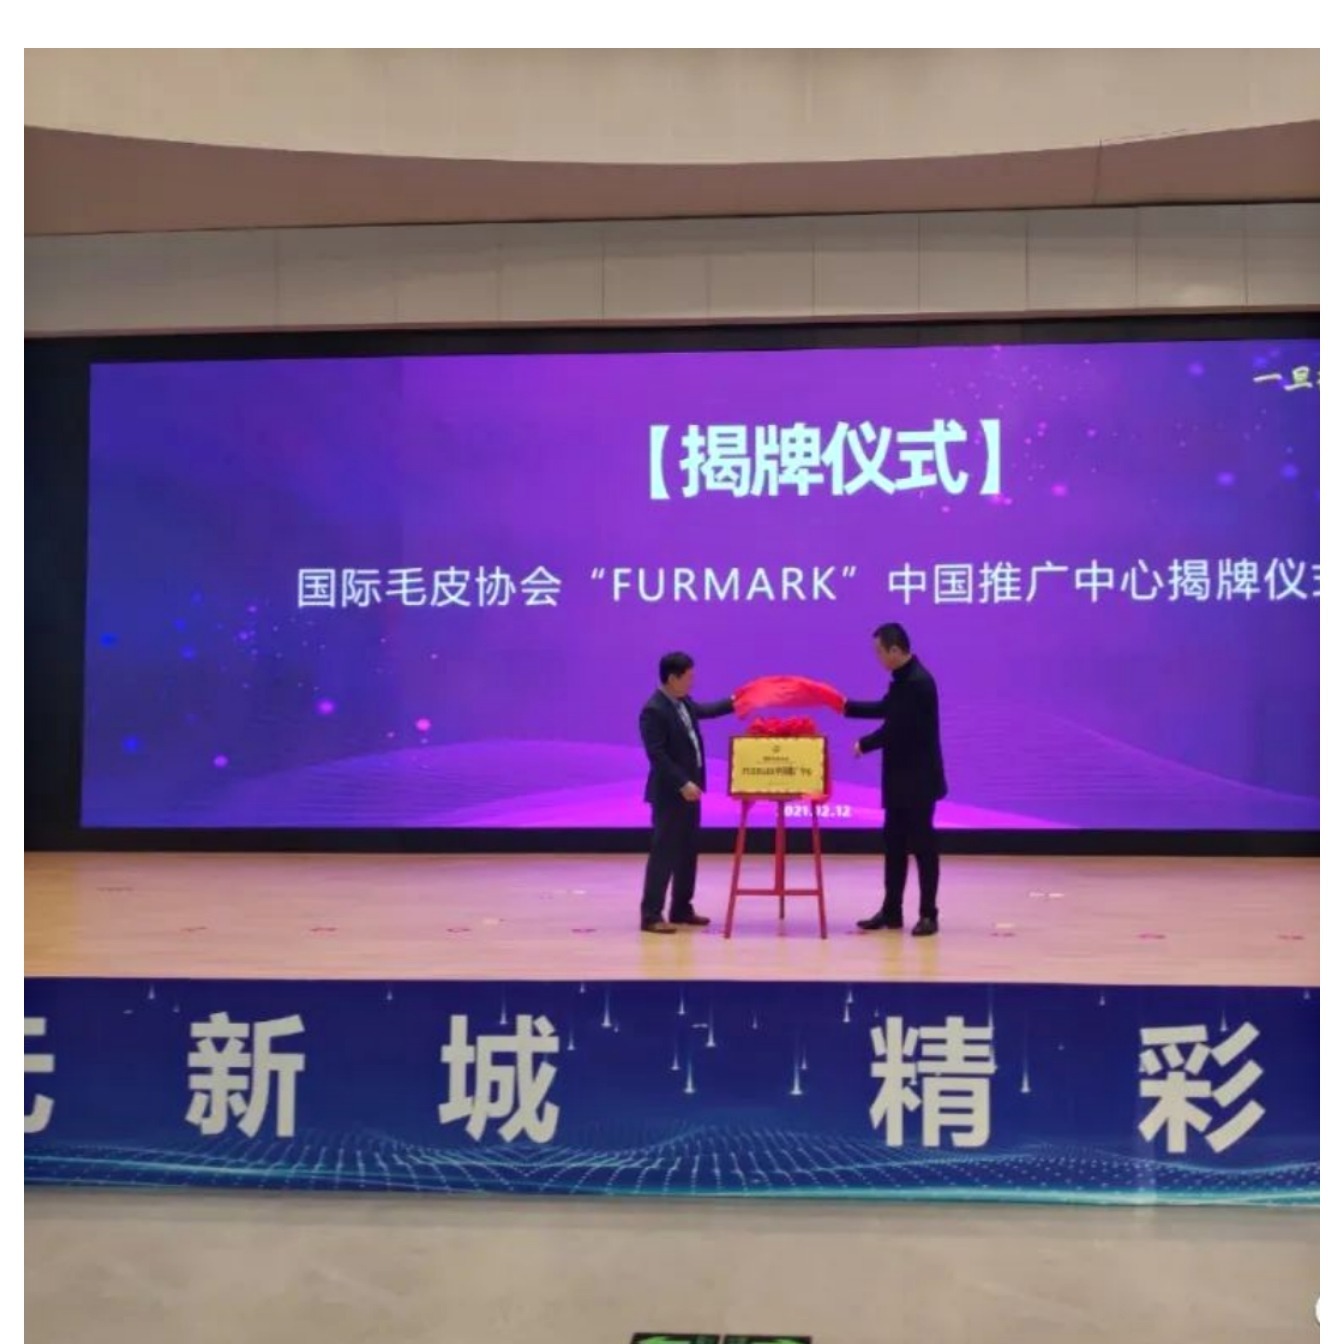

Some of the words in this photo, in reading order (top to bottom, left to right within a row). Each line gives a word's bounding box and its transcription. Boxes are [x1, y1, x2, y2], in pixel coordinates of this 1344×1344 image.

[297, 566, 562, 608] 国际毛皮协会
[888, 557, 1320, 605] 中国推广中心揭牌仪
